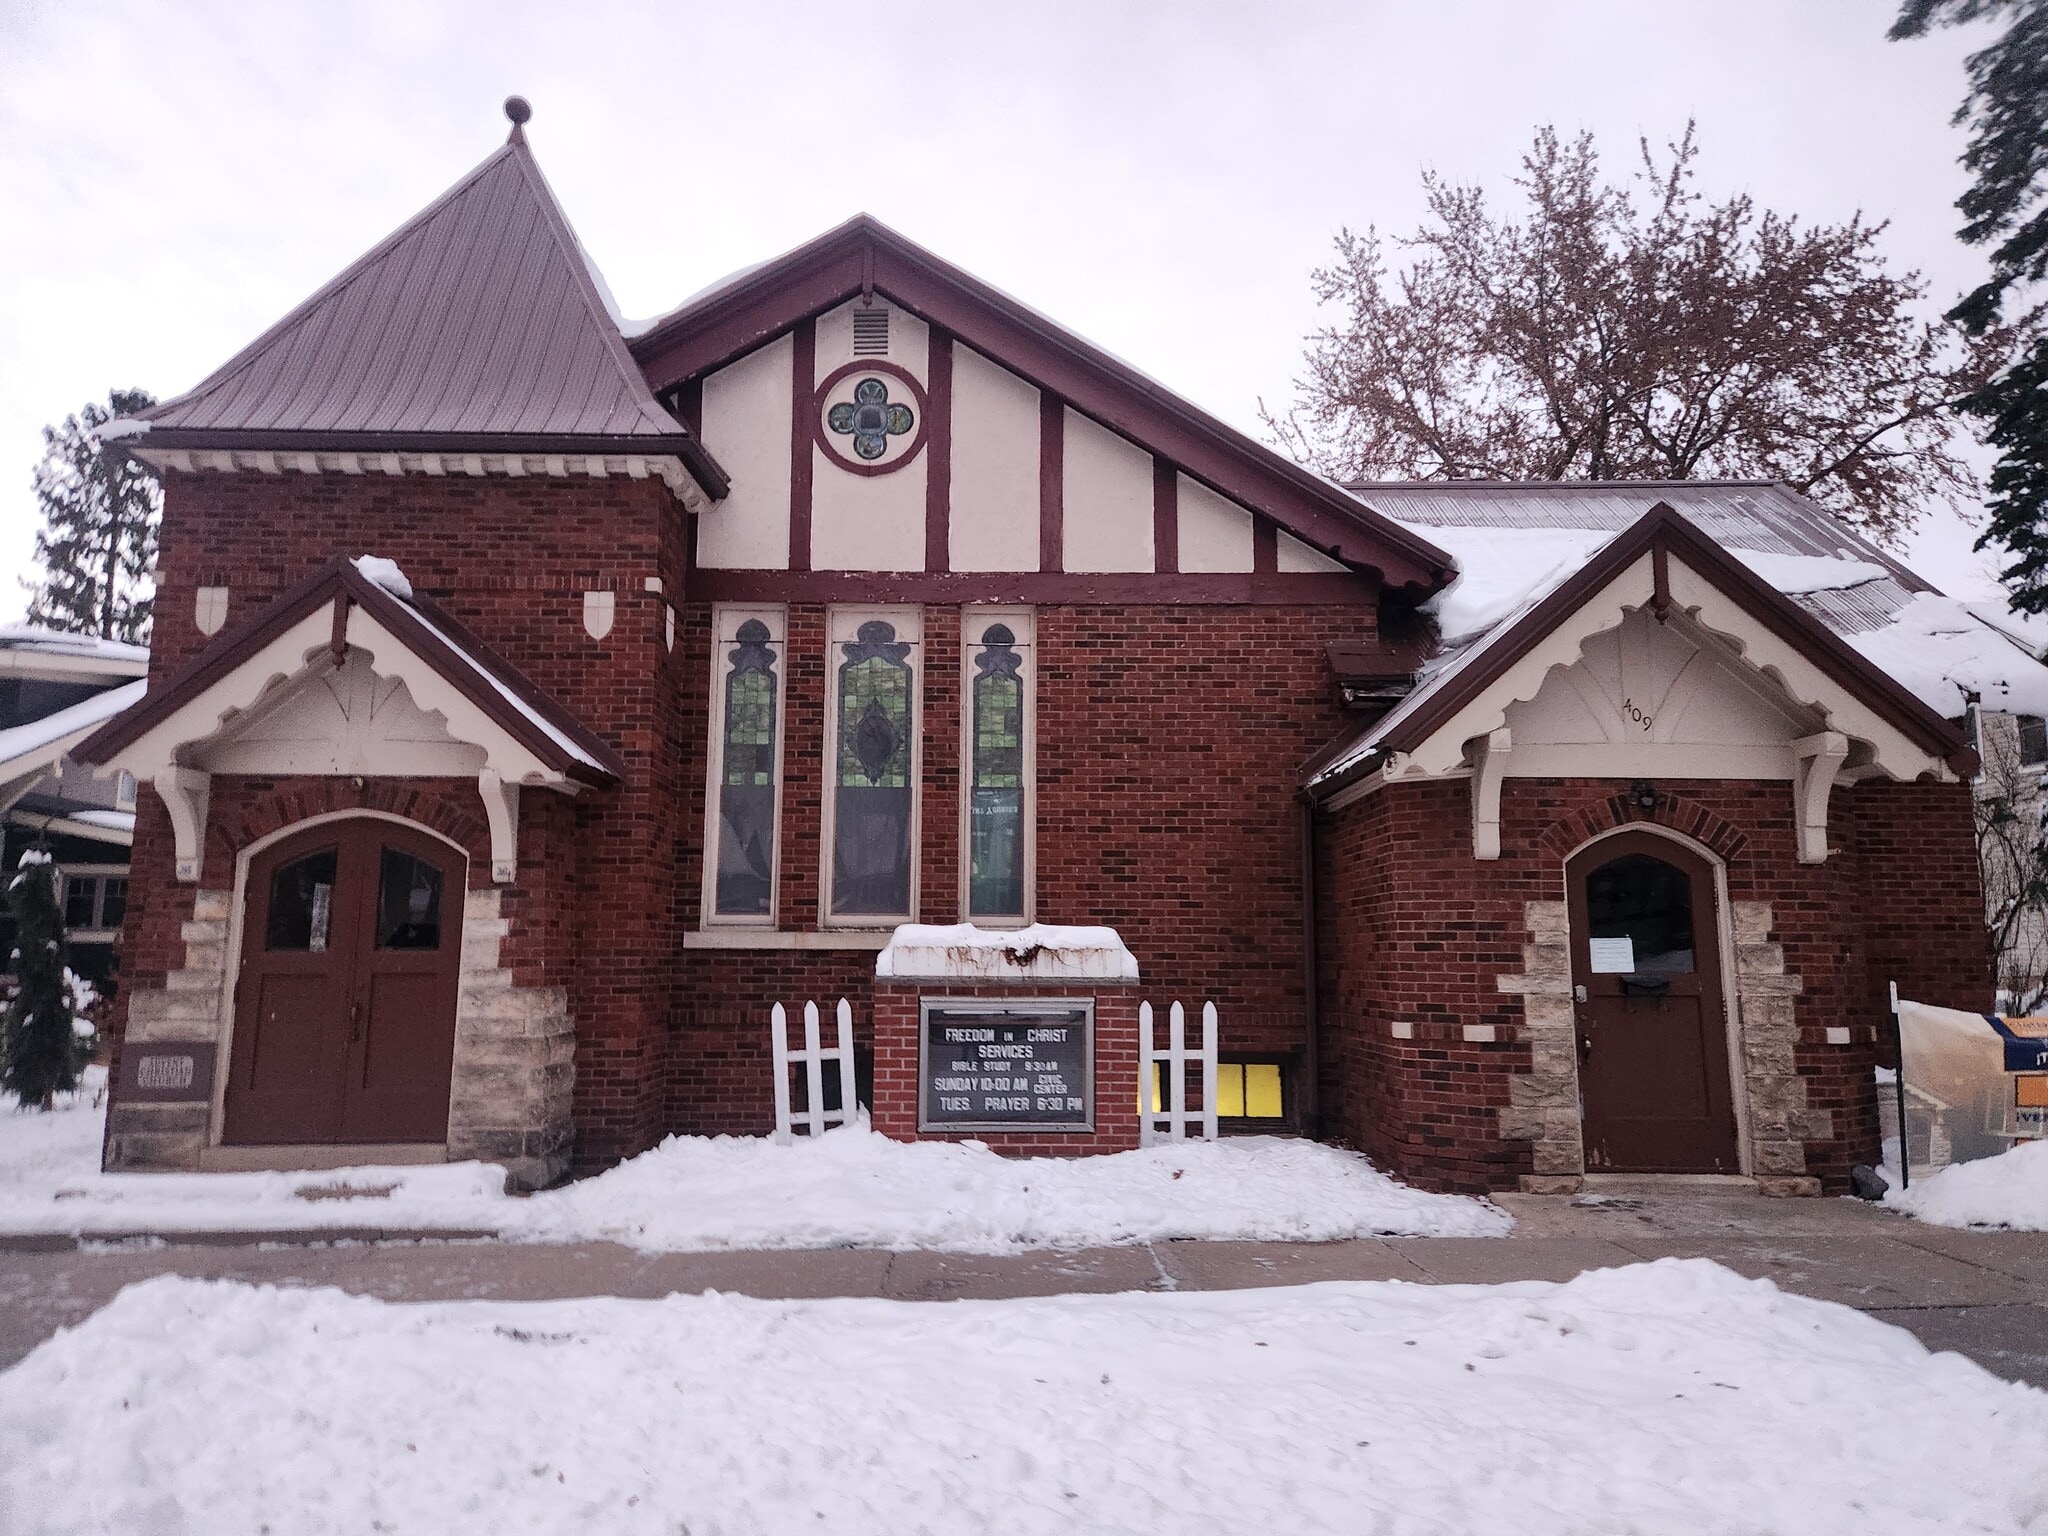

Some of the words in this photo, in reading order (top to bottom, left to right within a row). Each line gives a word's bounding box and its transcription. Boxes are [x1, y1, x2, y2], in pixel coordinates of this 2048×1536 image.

[1623, 698, 1653, 731] 409
[945, 1028, 995, 1042] FREEDOM
[1003, 1032, 1014, 1042] IN
[1027, 1029, 1068, 1042] CHRIST
[978, 1045, 1034, 1058] SERVICES
[951, 1061, 978, 1072] BIBLE
[983, 1061, 1011, 1072] STUDY
[934, 1077, 978, 1091] SUNDAY
[1013, 1077, 1028, 1091] AM
[1033, 1084, 1068, 1094] CENTER
[985, 1097, 1030, 1111] PRAYER
[1067, 1097, 1083, 1111] PM
